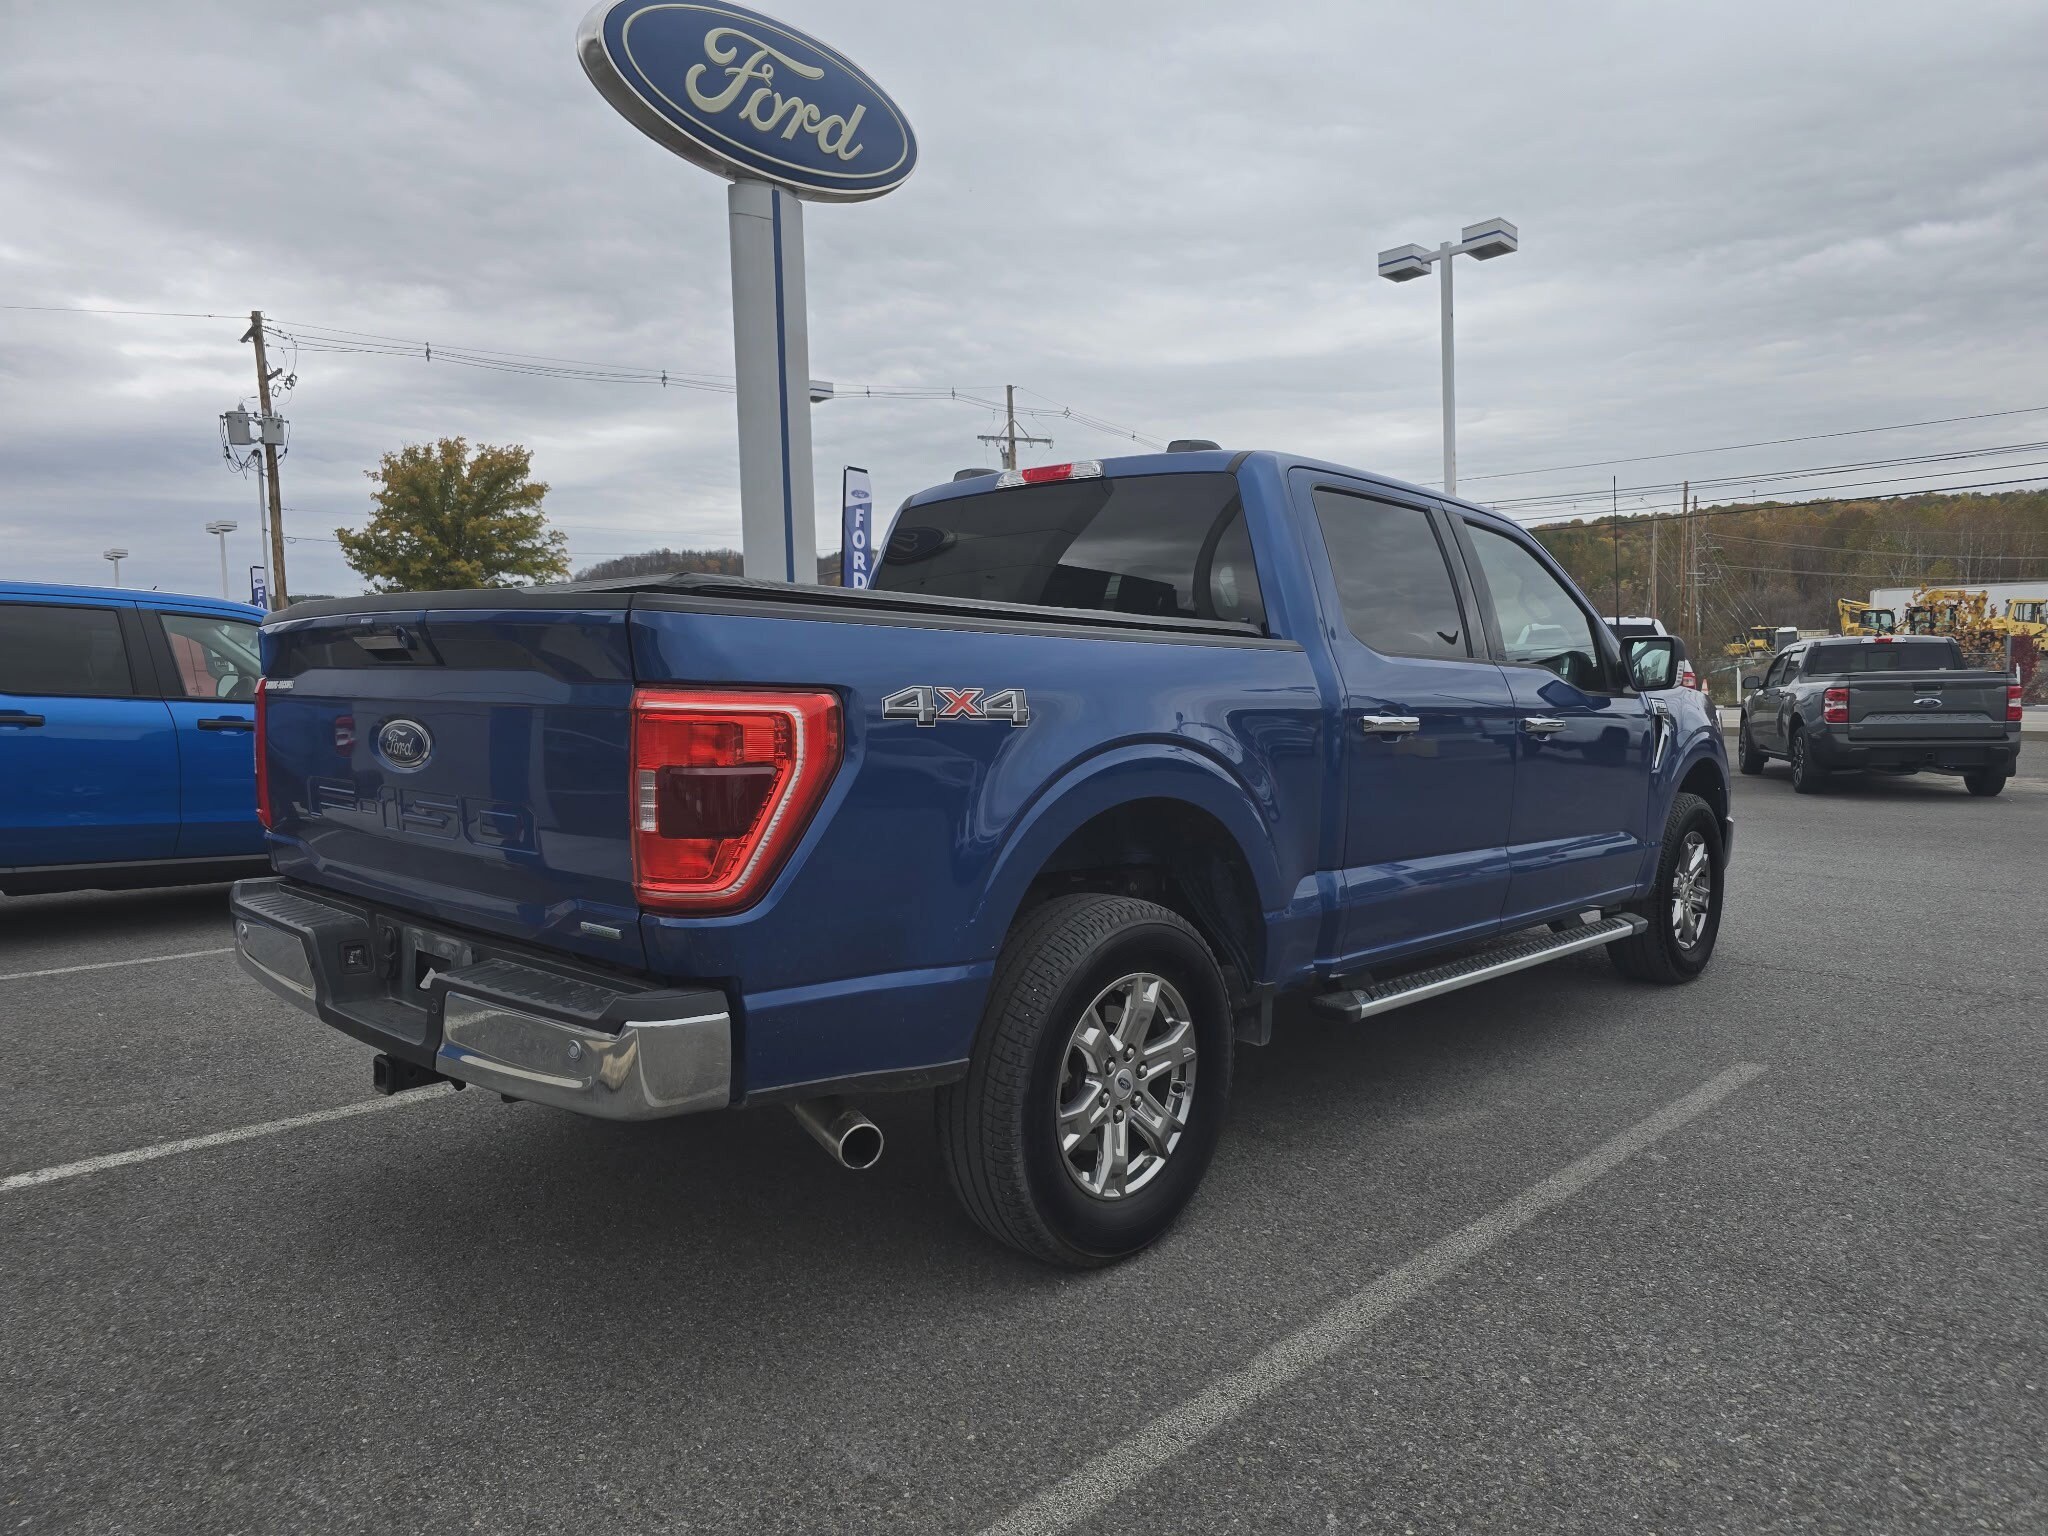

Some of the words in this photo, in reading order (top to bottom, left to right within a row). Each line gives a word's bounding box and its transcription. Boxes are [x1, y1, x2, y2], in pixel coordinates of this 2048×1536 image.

[685, 27, 867, 161] Ford
[852, 508, 868, 589] FORD
[386, 729, 414, 756] Ford
[881, 685, 1030, 728] 4X4
[308, 776, 540, 856] F-150
